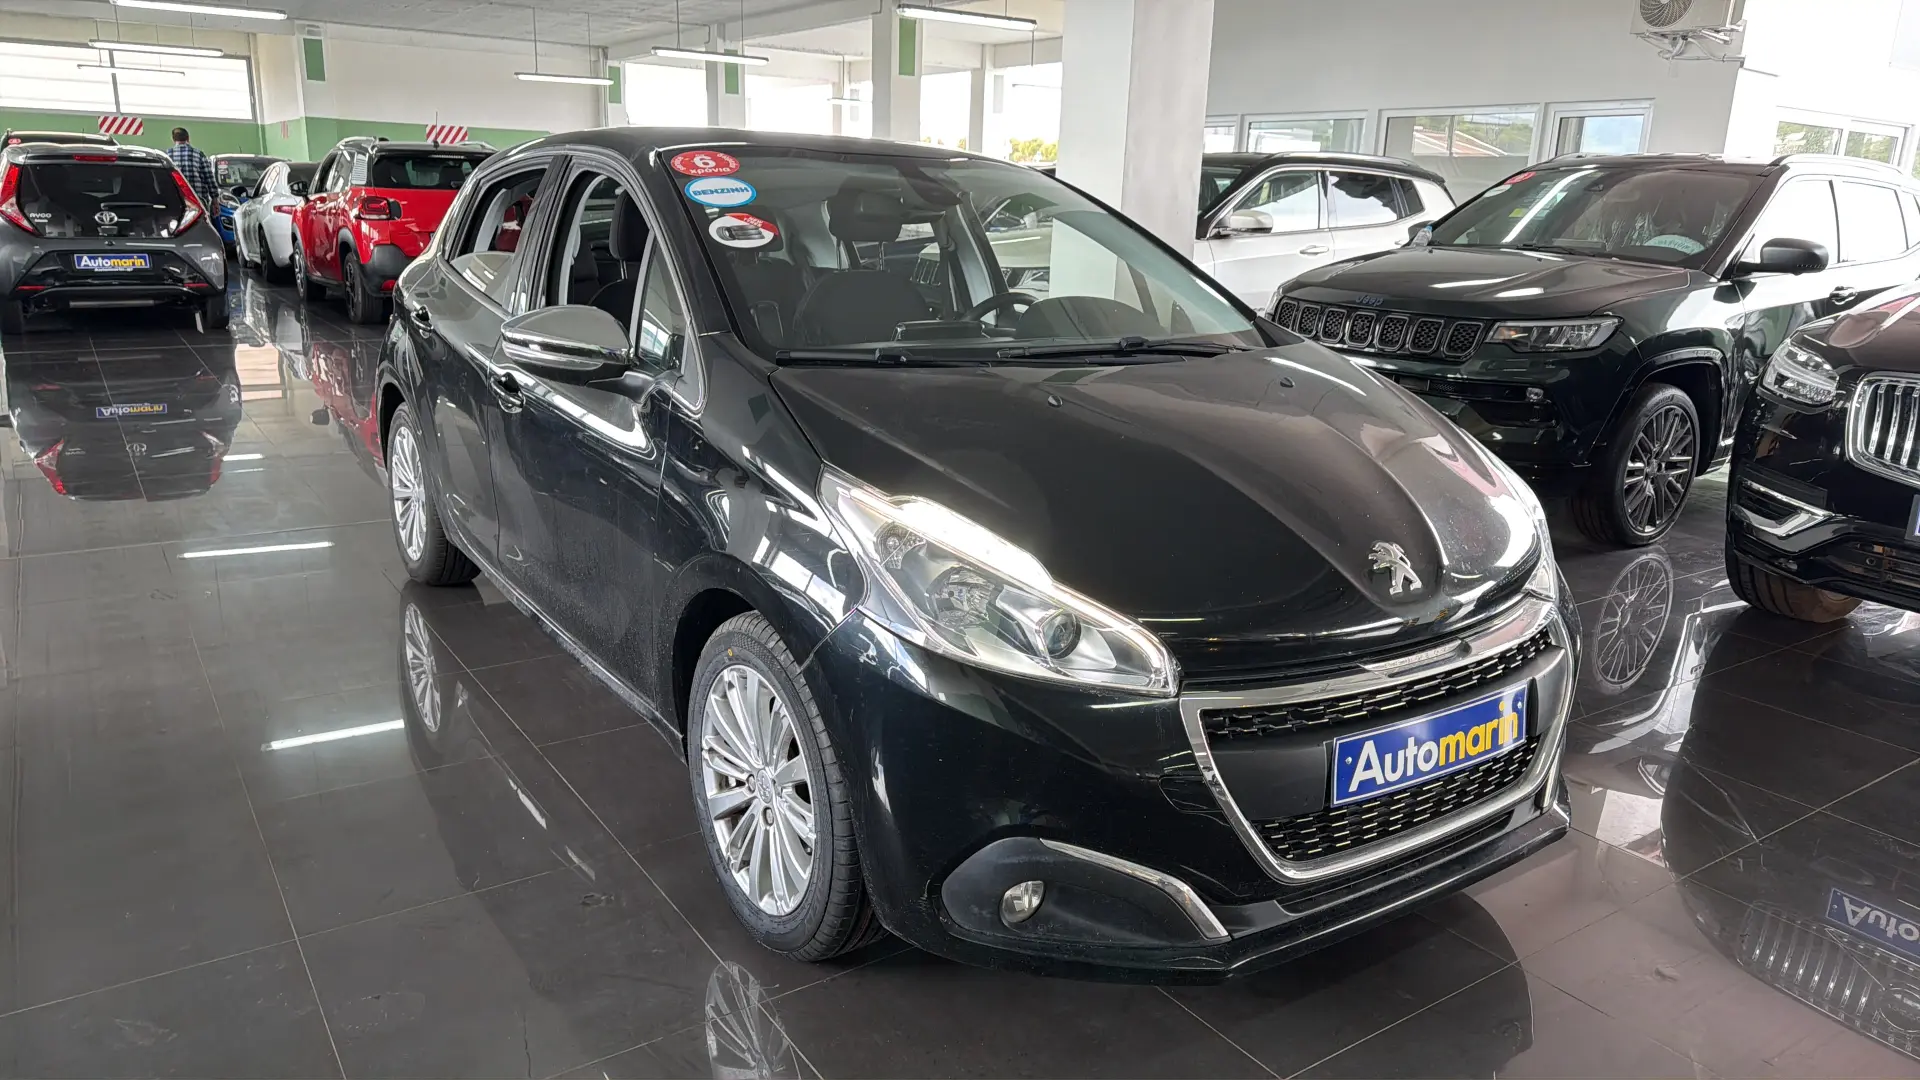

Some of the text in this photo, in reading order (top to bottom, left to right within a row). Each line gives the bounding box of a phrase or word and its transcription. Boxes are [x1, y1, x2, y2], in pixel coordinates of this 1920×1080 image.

[693, 155, 716, 168] 6
[80, 255, 146, 267] Automarin
[1355, 295, 1384, 307] Jeep
[1348, 701, 1519, 793] Automarin
